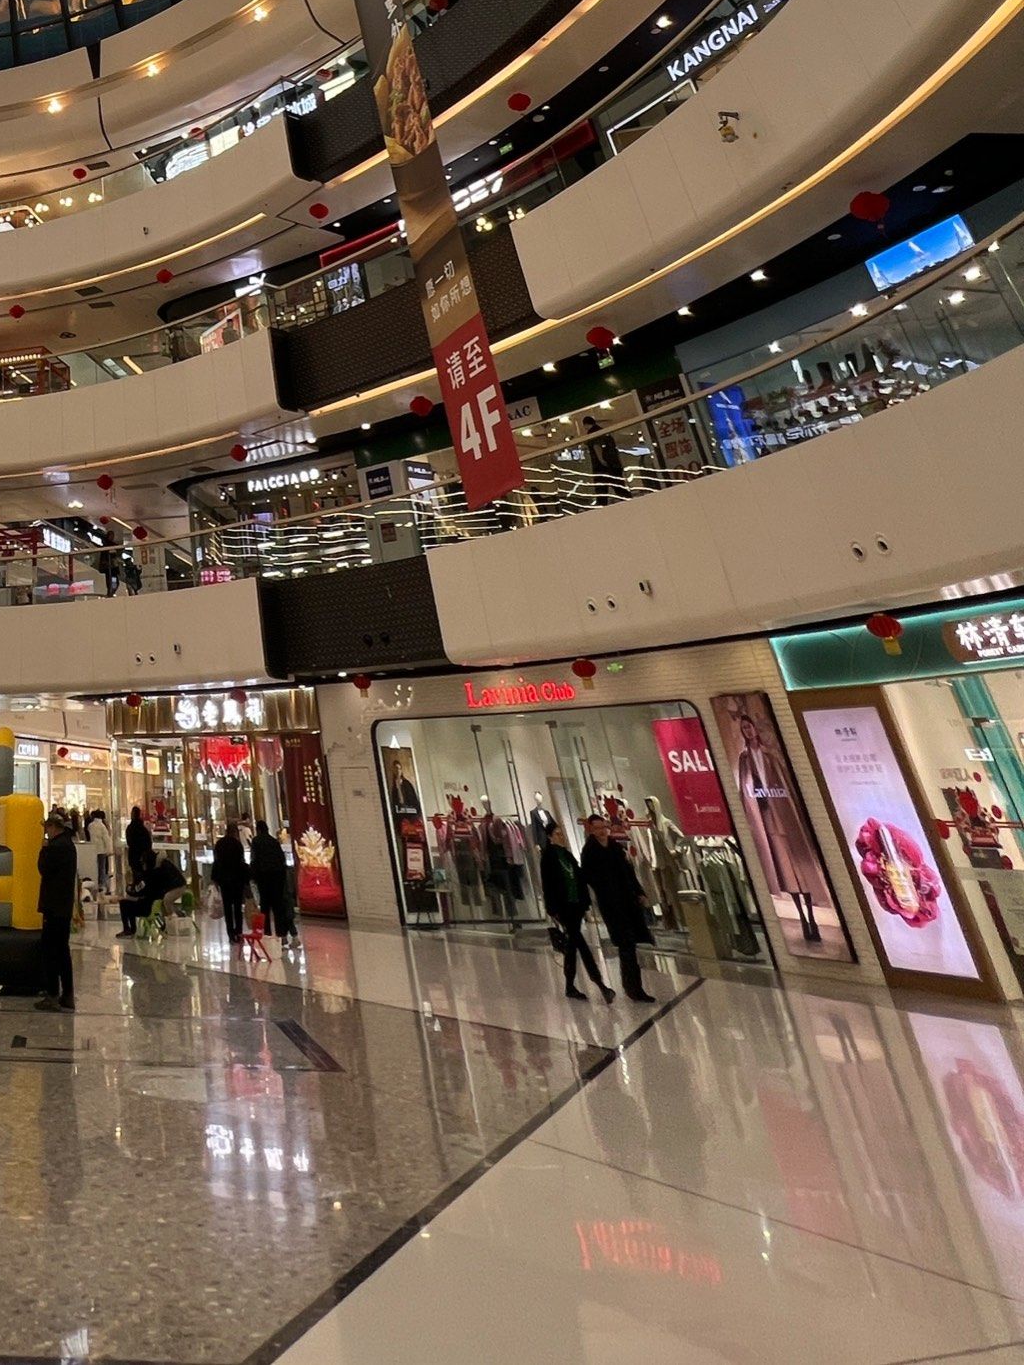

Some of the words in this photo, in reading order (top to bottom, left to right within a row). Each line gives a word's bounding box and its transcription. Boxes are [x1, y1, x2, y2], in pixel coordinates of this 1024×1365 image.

[666, 3, 759, 82] KANGNAI
[446, 335, 488, 390] 请至
[460, 384, 501, 461] 4F
[464, 676, 539, 708] Lavinia
[540, 680, 576, 702] Club
